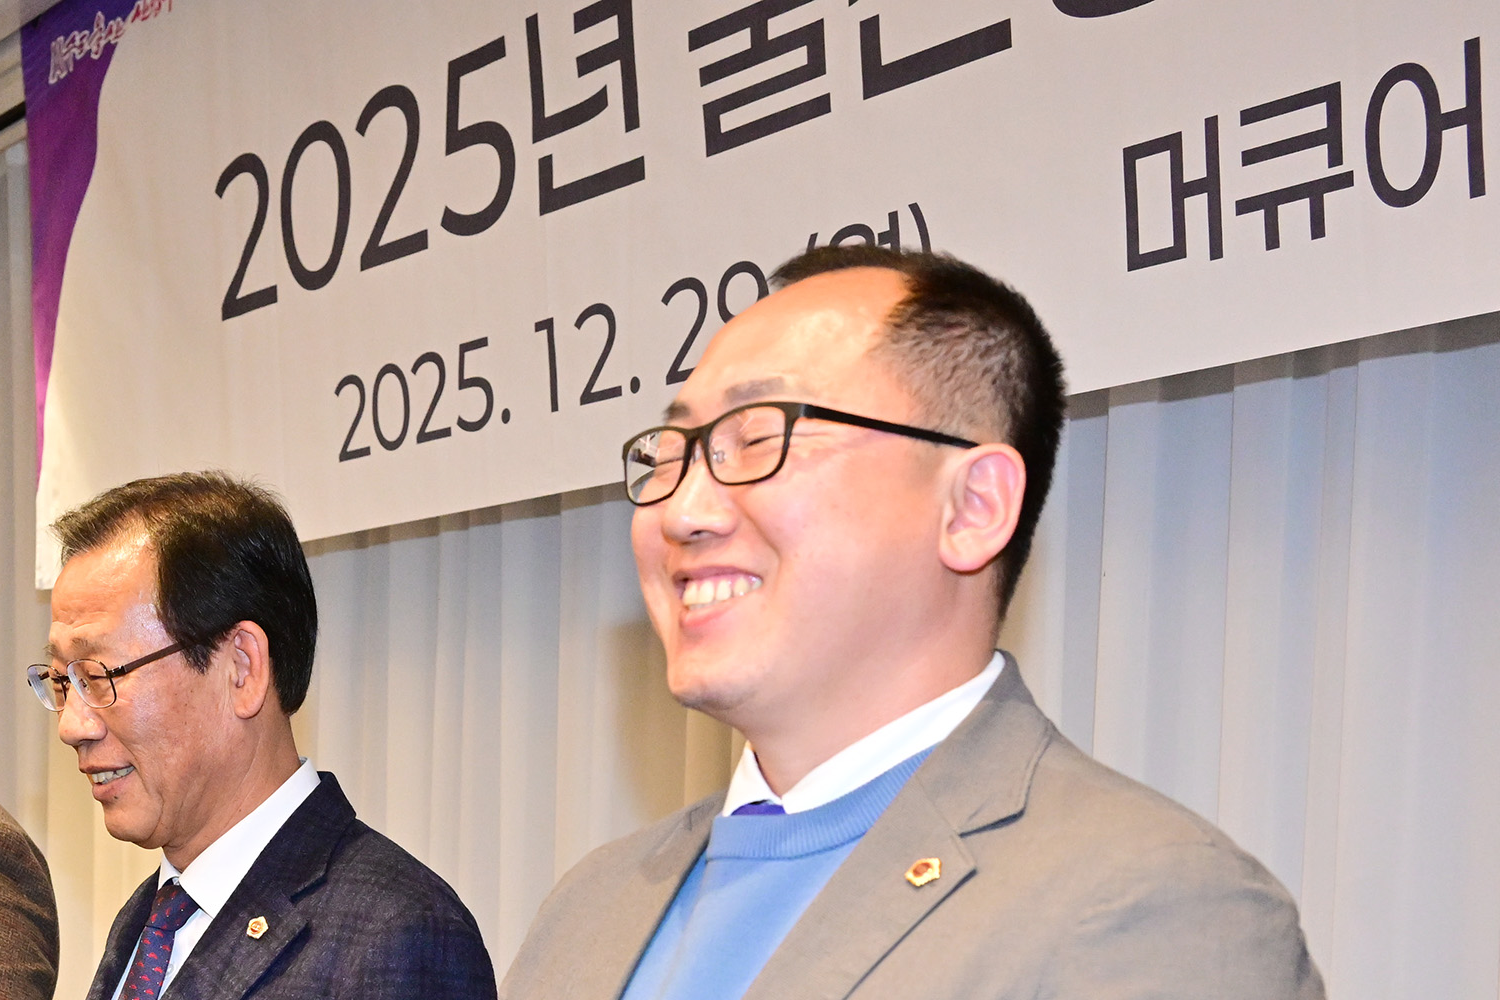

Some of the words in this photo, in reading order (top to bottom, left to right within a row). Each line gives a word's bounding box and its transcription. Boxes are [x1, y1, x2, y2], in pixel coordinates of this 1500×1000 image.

[215, 0, 646, 321] 2025년
[1123, 36, 1487, 272] 머큐어
[335, 336, 511, 462] 2025.
[534, 302, 641, 413] 12.
